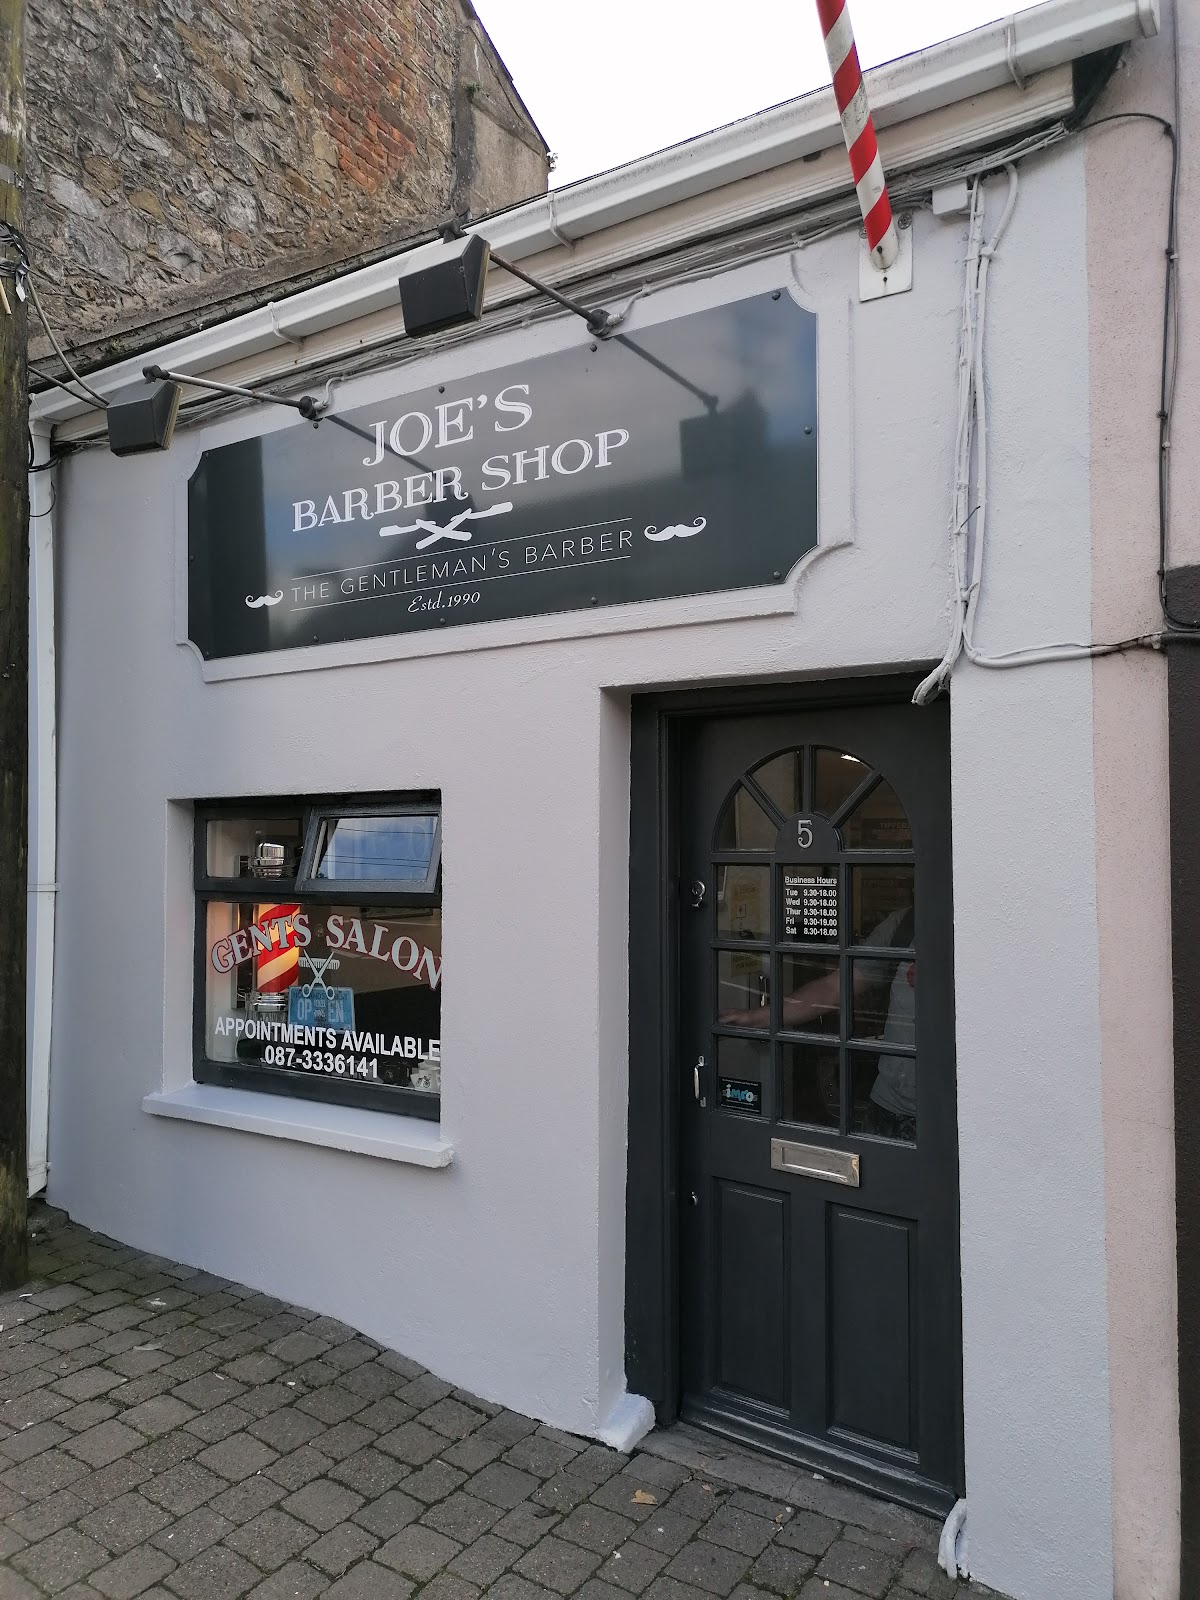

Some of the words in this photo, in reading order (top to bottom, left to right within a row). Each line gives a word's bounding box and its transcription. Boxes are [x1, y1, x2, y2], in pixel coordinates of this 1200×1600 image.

[362, 383, 533, 468] JOE'S
[292, 466, 469, 533] BARBER
[481, 428, 631, 492] SHOP
[291, 583, 331, 603] THE
[341, 548, 511, 593] GENTLEMAN'S
[524, 529, 633, 565] BARBER
[407, 591, 482, 614] Estd.1990
[797, 819, 813, 848] 5
[784, 876, 815, 884] Business
[816, 877, 838, 885] Hours
[803, 889, 837, 897] 9.30-18.00
[785, 898, 801, 906] Wed
[803, 899, 837, 907] 9.30-18.00
[803, 908, 837, 917] 9.30-18.00
[785, 917, 795, 925] Fri
[803, 918, 837, 926] 9.30-19.00
[785, 926, 797, 934] Sat
[803, 927, 838, 936] 8.30-18.00
[211, 914, 313, 974] GENTS
[325, 914, 443, 991] SALON
[215, 1016, 336, 1048] APPOINTMENTS
[341, 1031, 441, 1061] AVAILABLE
[265, 1045, 378, 1078] 087-3336141
